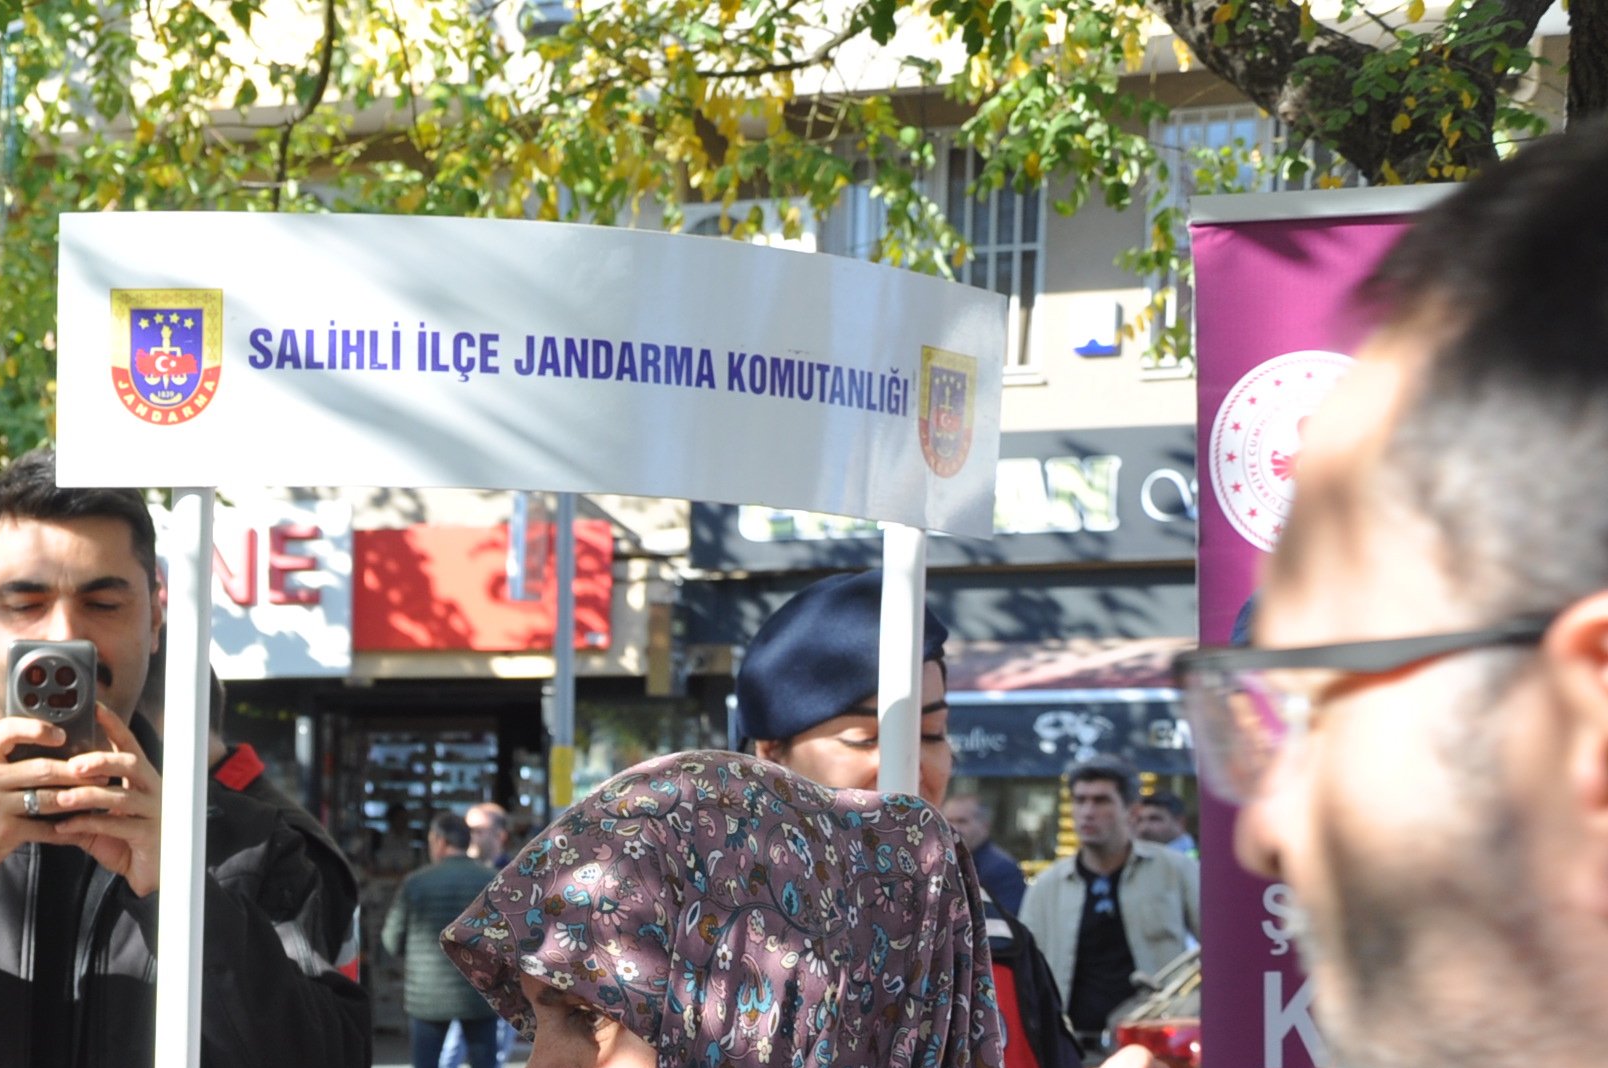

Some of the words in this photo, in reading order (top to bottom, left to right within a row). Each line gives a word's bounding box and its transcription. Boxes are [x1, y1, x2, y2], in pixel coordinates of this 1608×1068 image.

[117, 379, 216, 423] JANDARMA
[247, 319, 401, 371] SALİHLİ
[417, 321, 500, 383] İLÇE
[514, 334, 717, 390] JANDARMA
[727, 351, 910, 417] KOMUTANLIĞI
